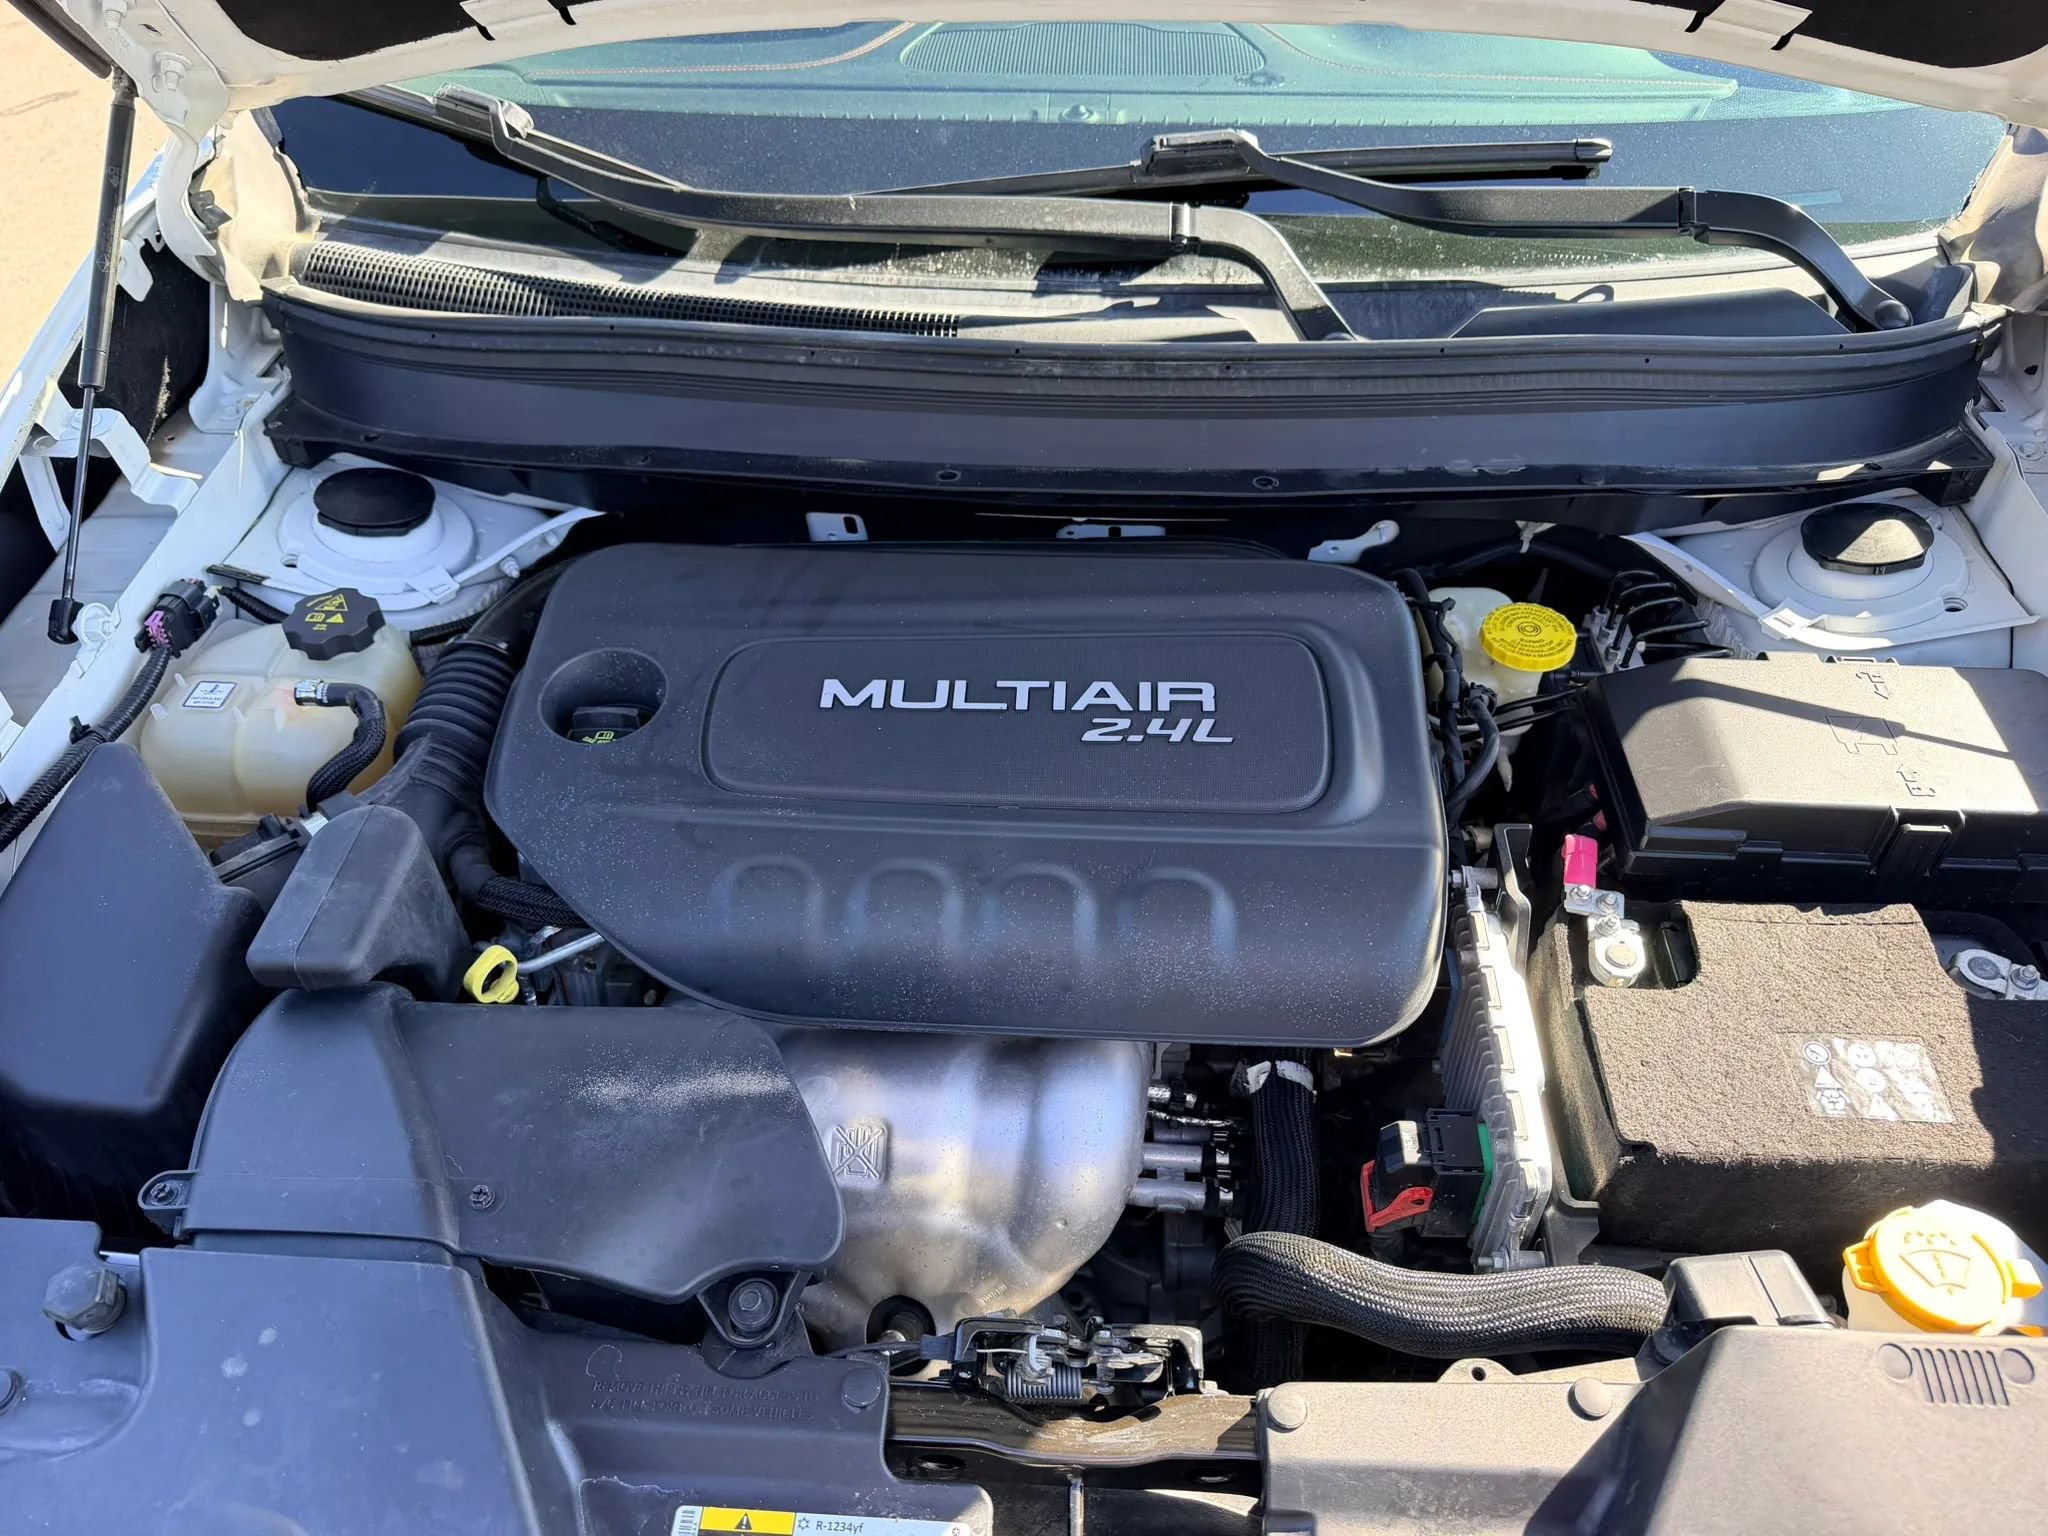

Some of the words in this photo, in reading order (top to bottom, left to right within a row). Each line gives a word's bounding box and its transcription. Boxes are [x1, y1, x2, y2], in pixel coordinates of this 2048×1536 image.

[819, 678, 1217, 712] MULTIAIR
[1081, 717, 1235, 743] 2.4L
[815, 1520, 864, 1535] R-1234yf
